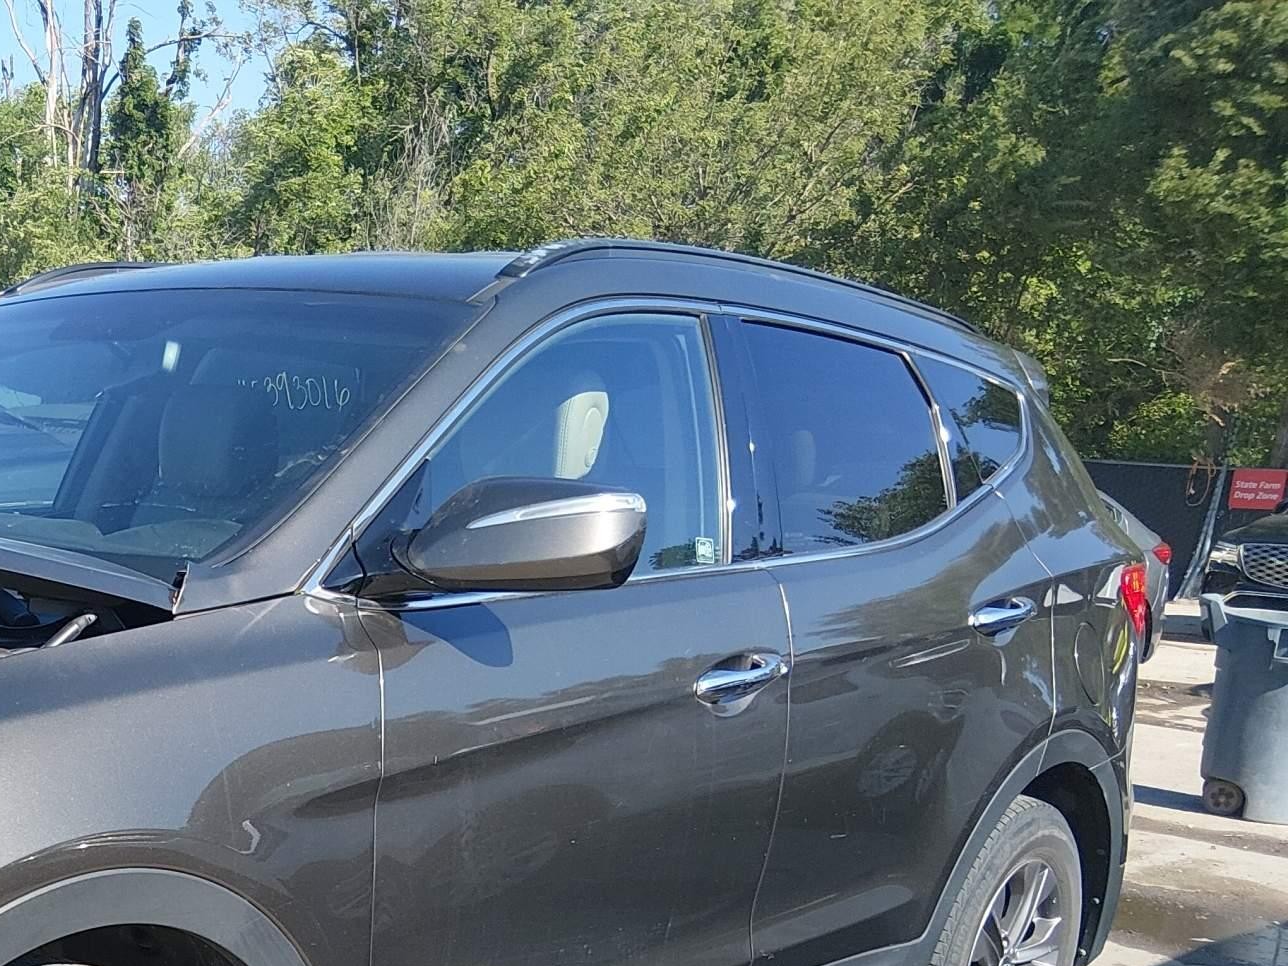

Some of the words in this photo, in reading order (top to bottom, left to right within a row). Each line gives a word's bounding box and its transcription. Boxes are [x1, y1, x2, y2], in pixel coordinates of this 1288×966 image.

[237, 371, 351, 412] 393016
[1235, 481, 1258, 489] State
[1258, 481, 1281, 489] Farm
[1234, 491, 1255, 500] Drop
[1256, 491, 1279, 500] Zone
